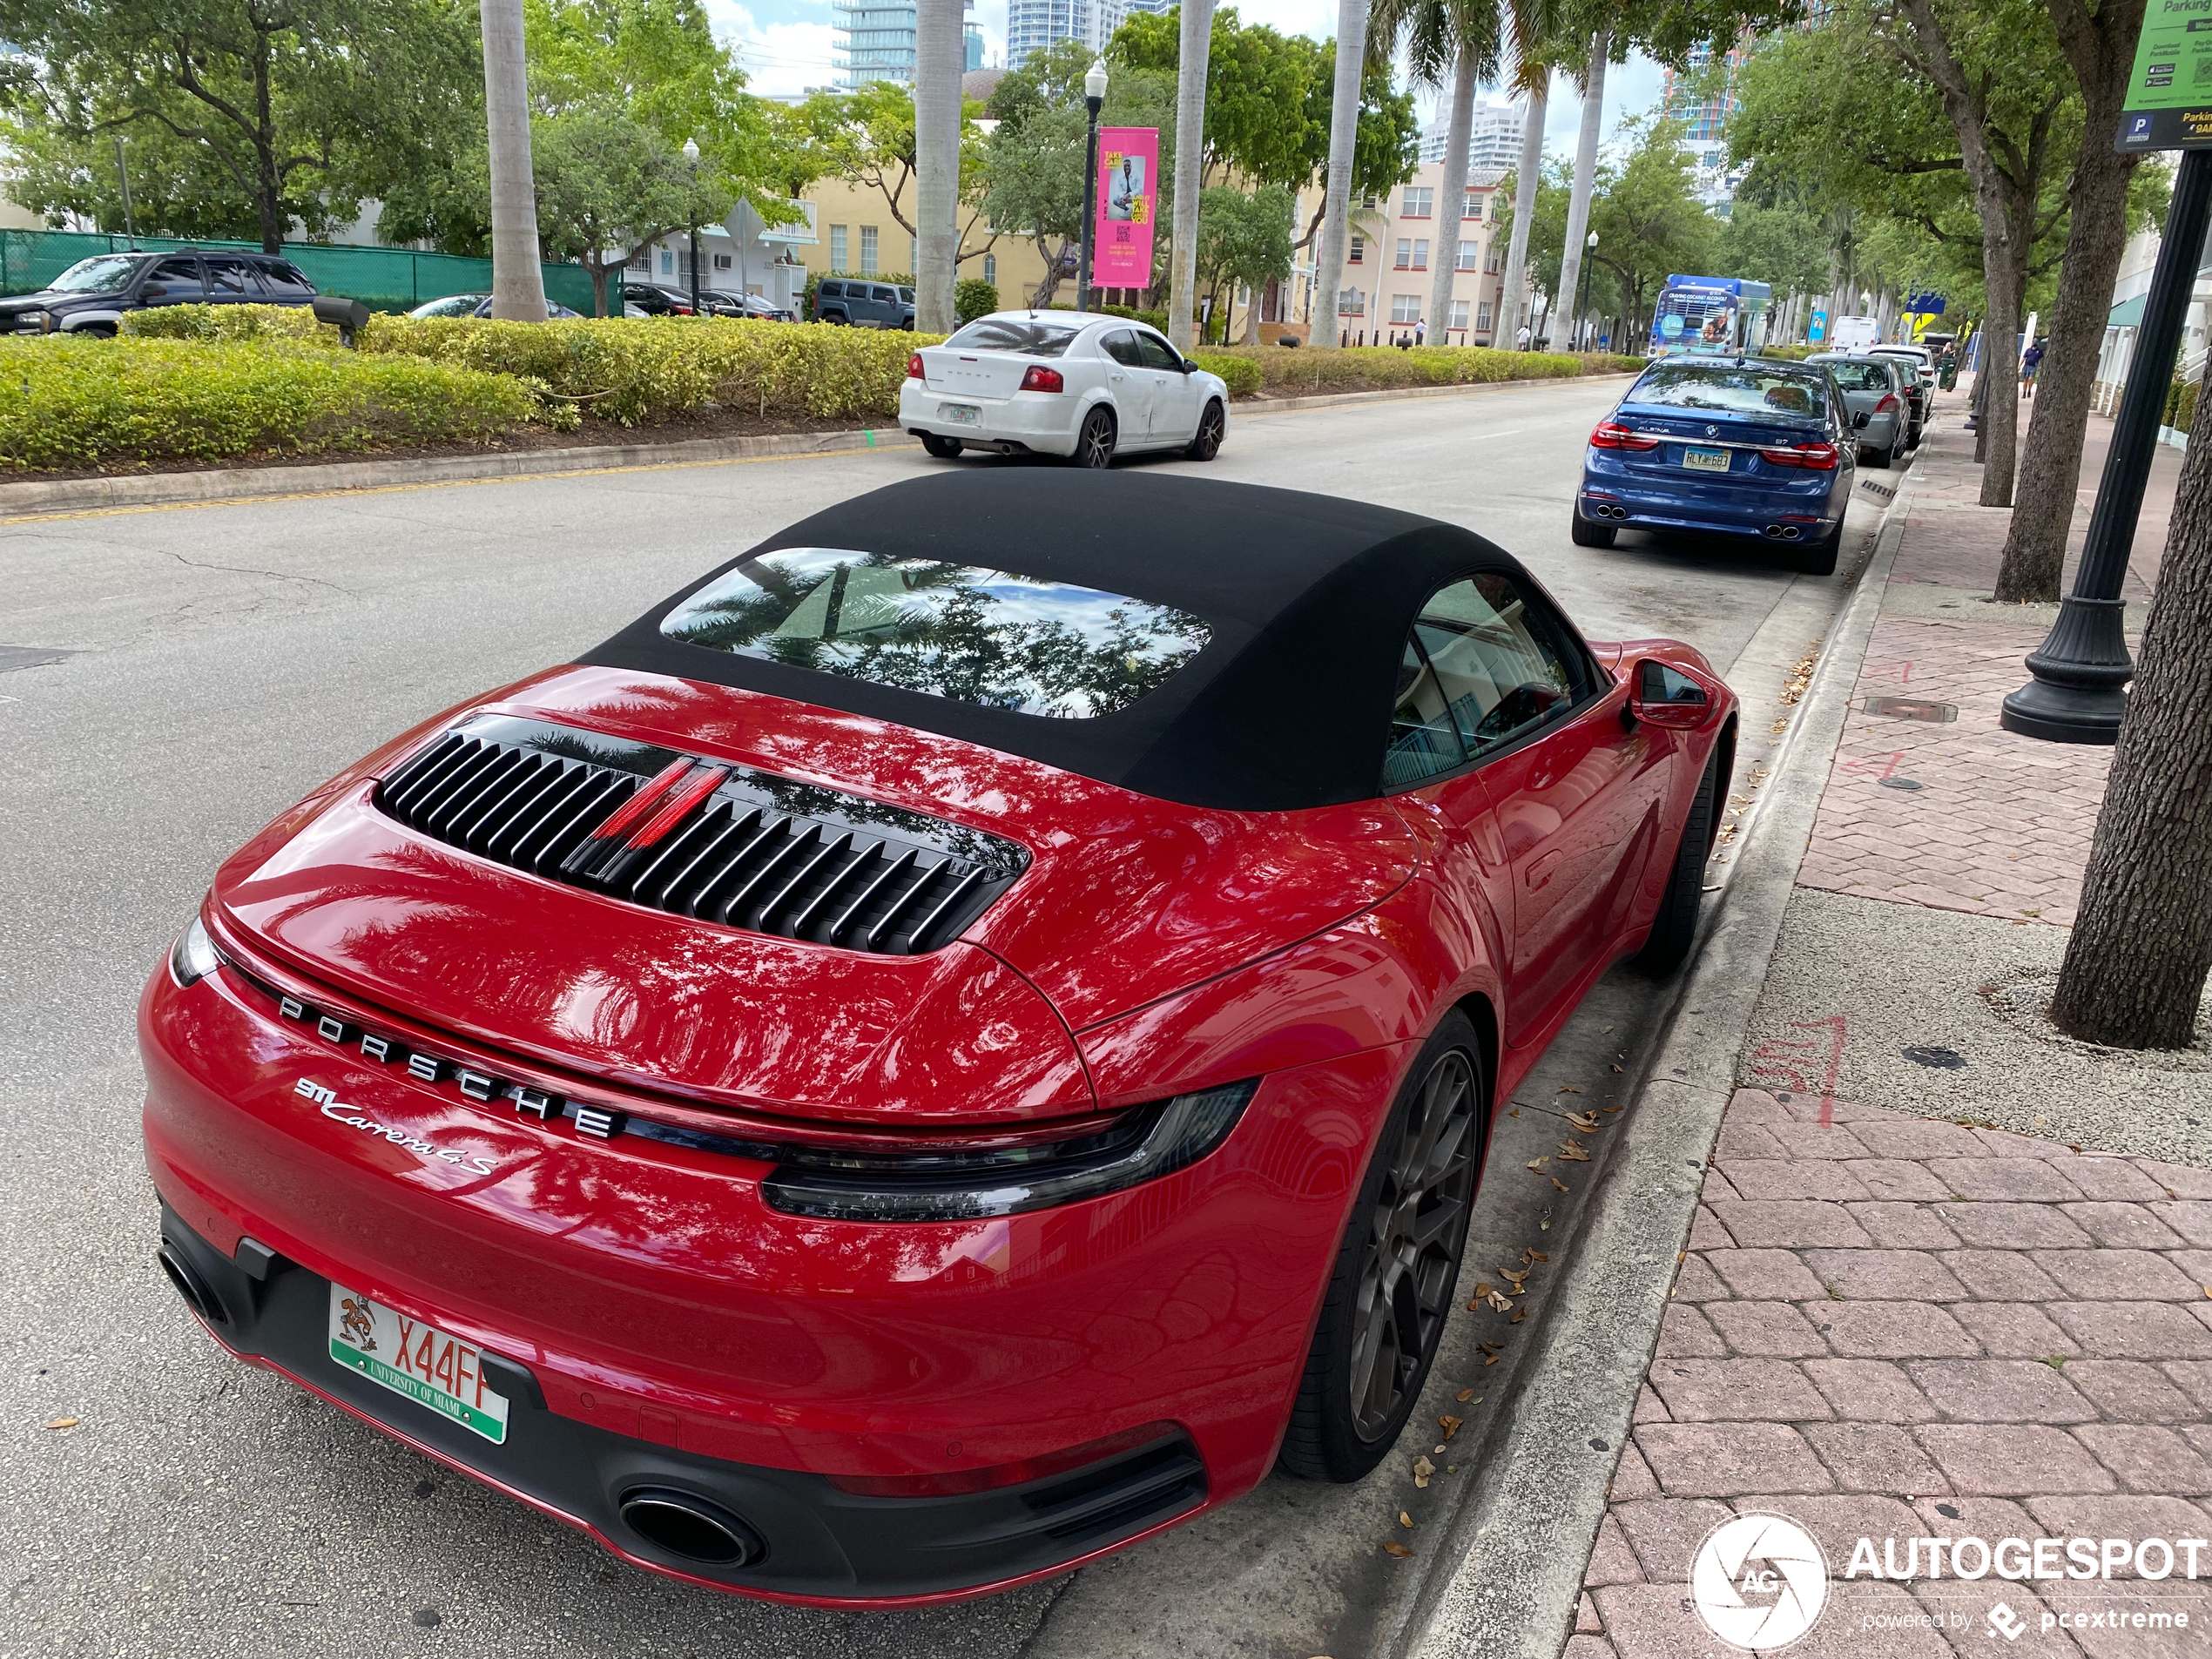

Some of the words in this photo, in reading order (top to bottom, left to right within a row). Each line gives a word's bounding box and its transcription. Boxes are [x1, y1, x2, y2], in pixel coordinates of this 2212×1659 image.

[2163, 0, 2211, 12] Parking
[2134, 118, 2147, 132] P
[1712, 455, 1729, 467] 683
[279, 995, 611, 1137] PORSCHE
[293, 1077, 337, 1105] 911
[320, 1103, 436, 1156] Carrera
[370, 1361, 420, 1393] UNIVERSITY
[420, 1386, 432, 1401] OF
[434, 1392, 460, 1417] MIAMI
